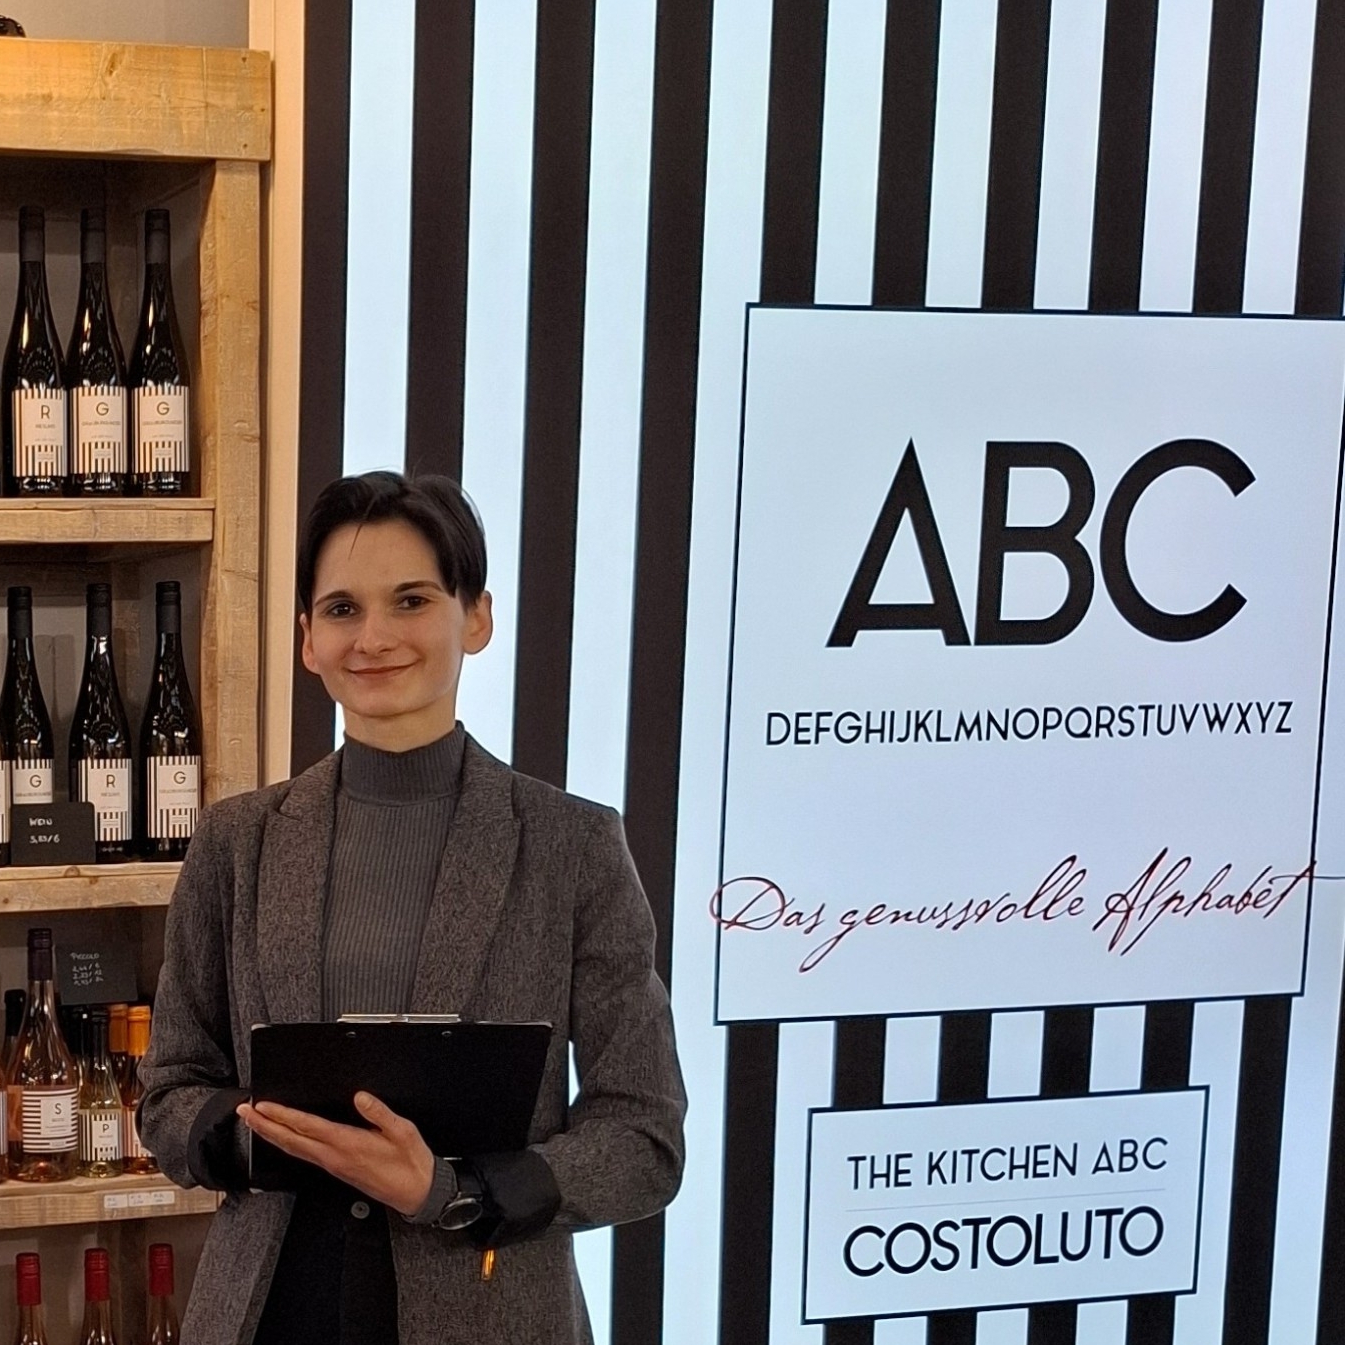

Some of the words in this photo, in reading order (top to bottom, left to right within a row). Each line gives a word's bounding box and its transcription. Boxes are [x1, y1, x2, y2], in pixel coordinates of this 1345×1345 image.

[41, 405, 50, 419] R
[96, 402, 109, 416] G
[157, 402, 170, 415] G
[825, 437, 1256, 647] ABC
[765, 701, 1294, 746] DEFGHIJKLMNOPQRSTUVWXYZ
[29, 775, 41, 788] G
[107, 775, 115, 788] R
[174, 771, 186, 784] G
[709, 876, 826, 934] Das
[798, 854, 1086, 973] genussvolle
[1092, 847, 1345, 957] Alphabet
[55, 1103, 62, 1115] S
[103, 1124, 109, 1133] P
[847, 1152, 912, 1190] THE
[927, 1141, 1078, 1186] KITCHEN
[1092, 1136, 1169, 1175] ABC
[842, 1205, 1164, 1277] COSTOLUTO
